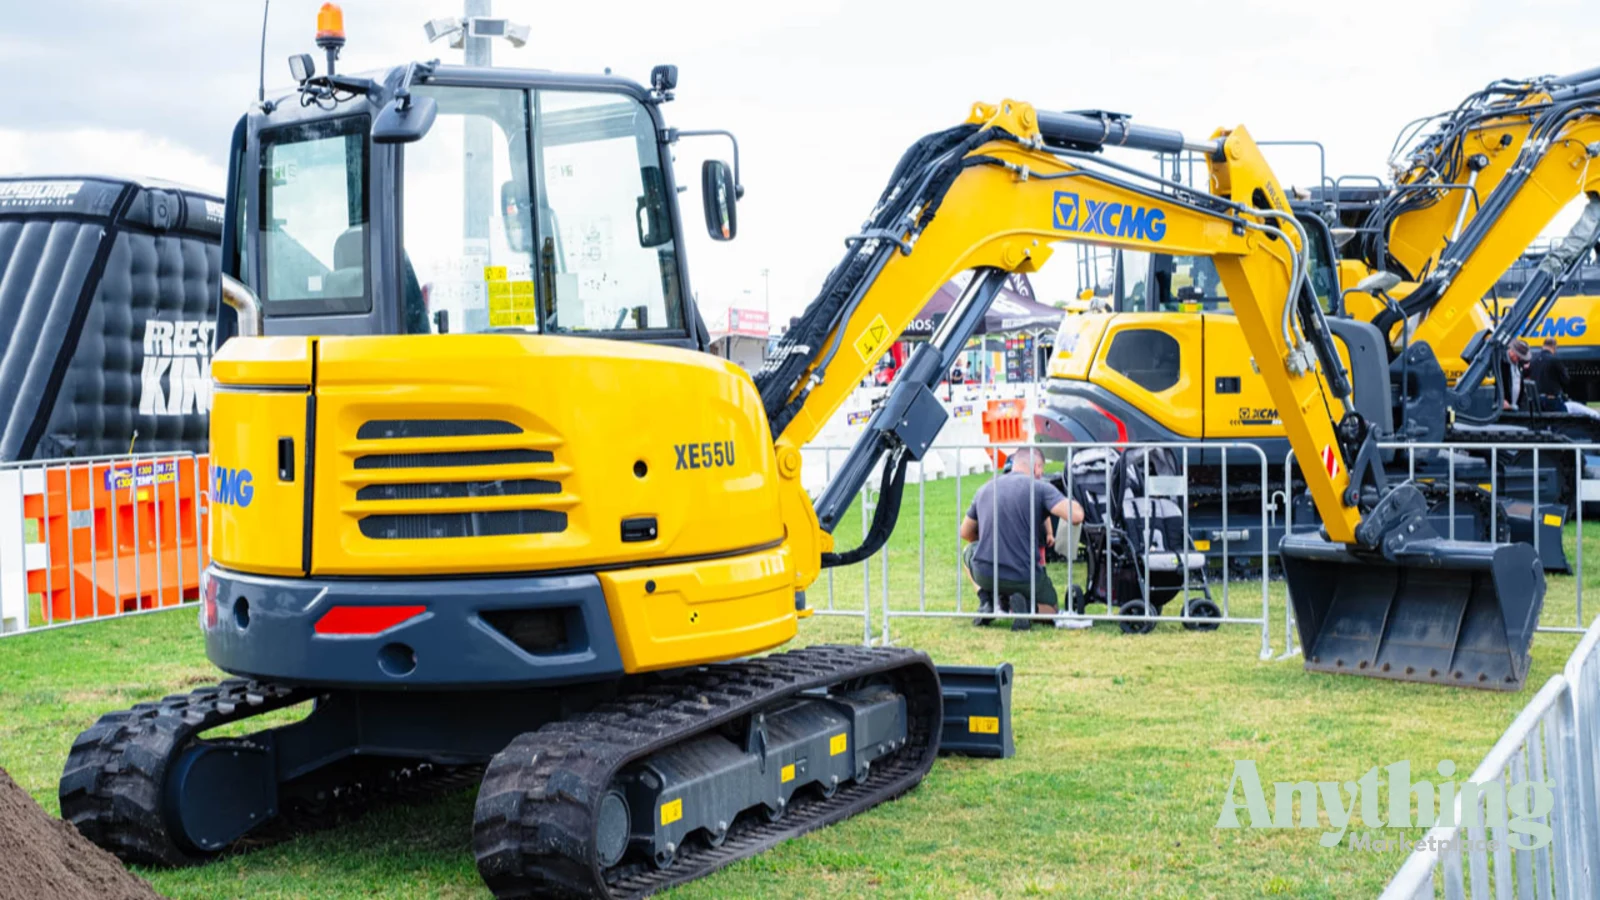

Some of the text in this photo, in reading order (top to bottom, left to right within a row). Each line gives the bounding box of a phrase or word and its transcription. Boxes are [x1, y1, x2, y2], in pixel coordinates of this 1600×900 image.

[1077, 198, 1167, 242] XCMG
[139, 356, 211, 416] KIN
[674, 441, 735, 471] XE55U
